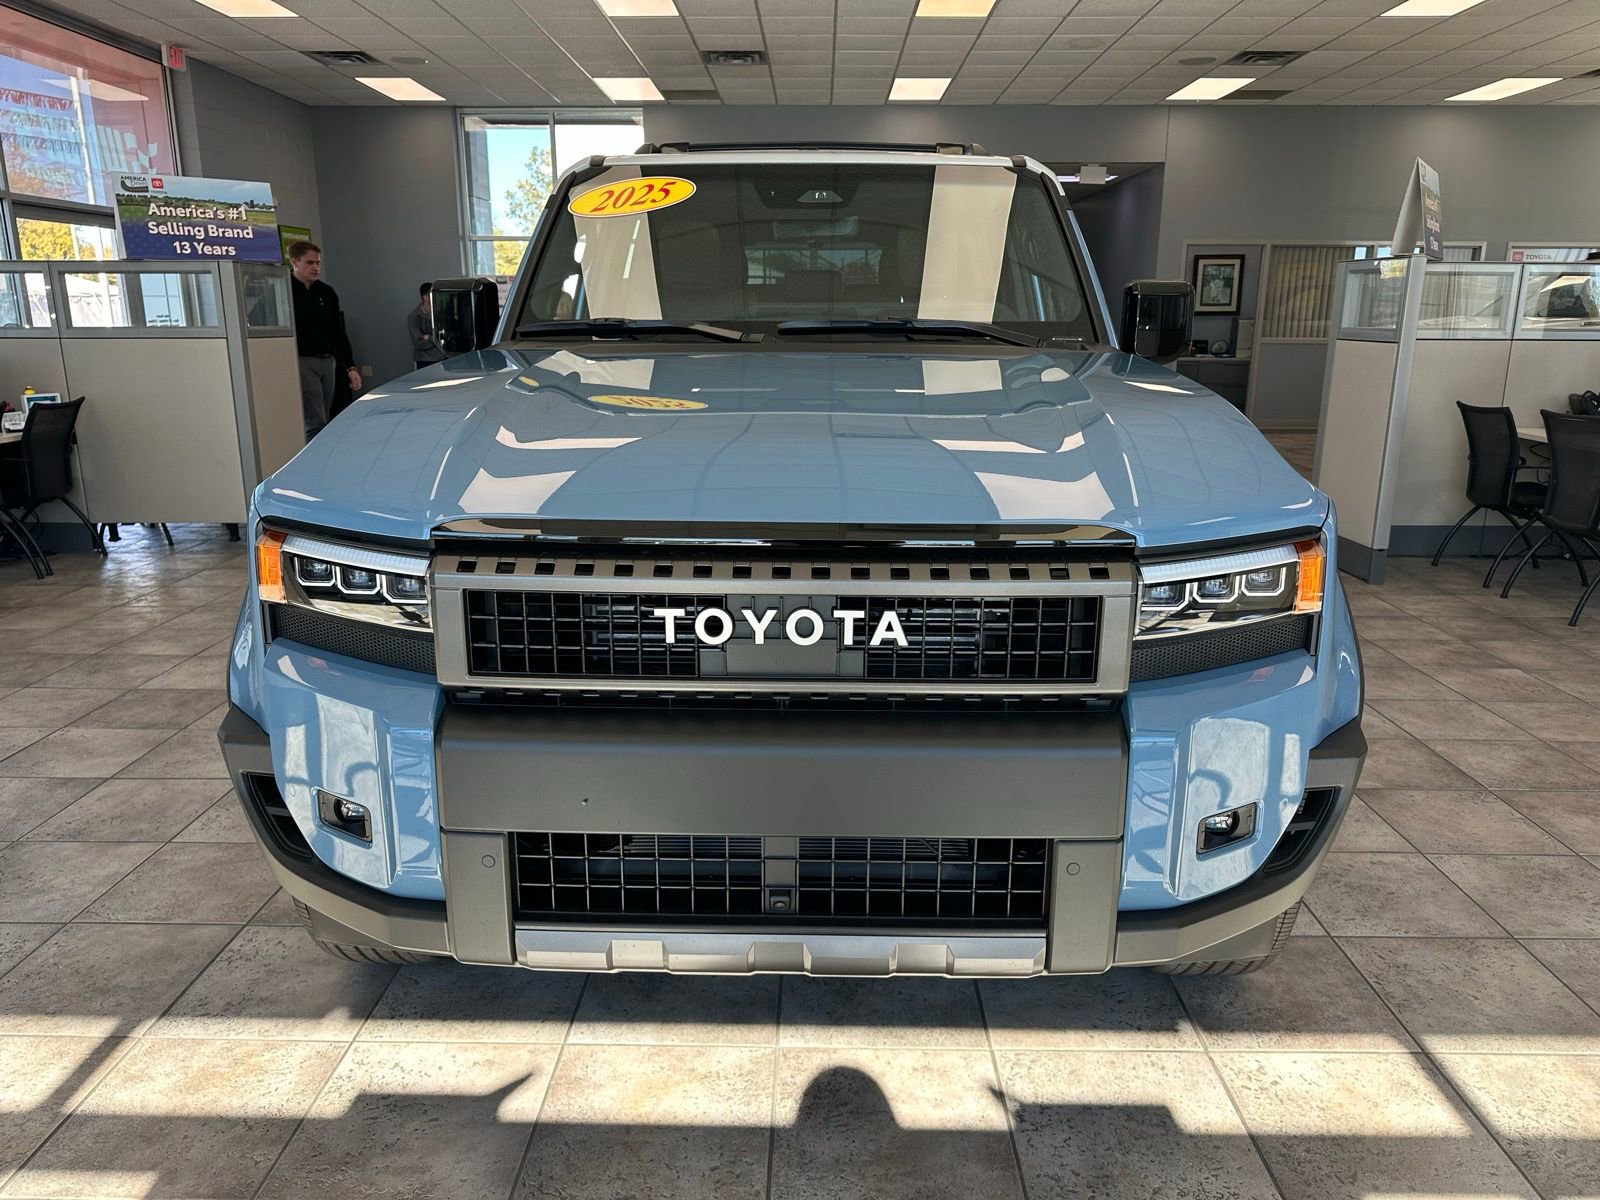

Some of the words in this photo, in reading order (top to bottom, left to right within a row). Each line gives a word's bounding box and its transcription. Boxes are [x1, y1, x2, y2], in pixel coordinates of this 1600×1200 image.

[590, 181, 676, 213] 2025
[148, 203, 225, 219] America's
[228, 205, 247, 220] #1
[148, 222, 205, 239] Selling
[208, 225, 254, 239] Brand
[173, 241, 191, 254] 13
[194, 242, 236, 256] Years
[653, 608, 909, 647] TOYOTA
